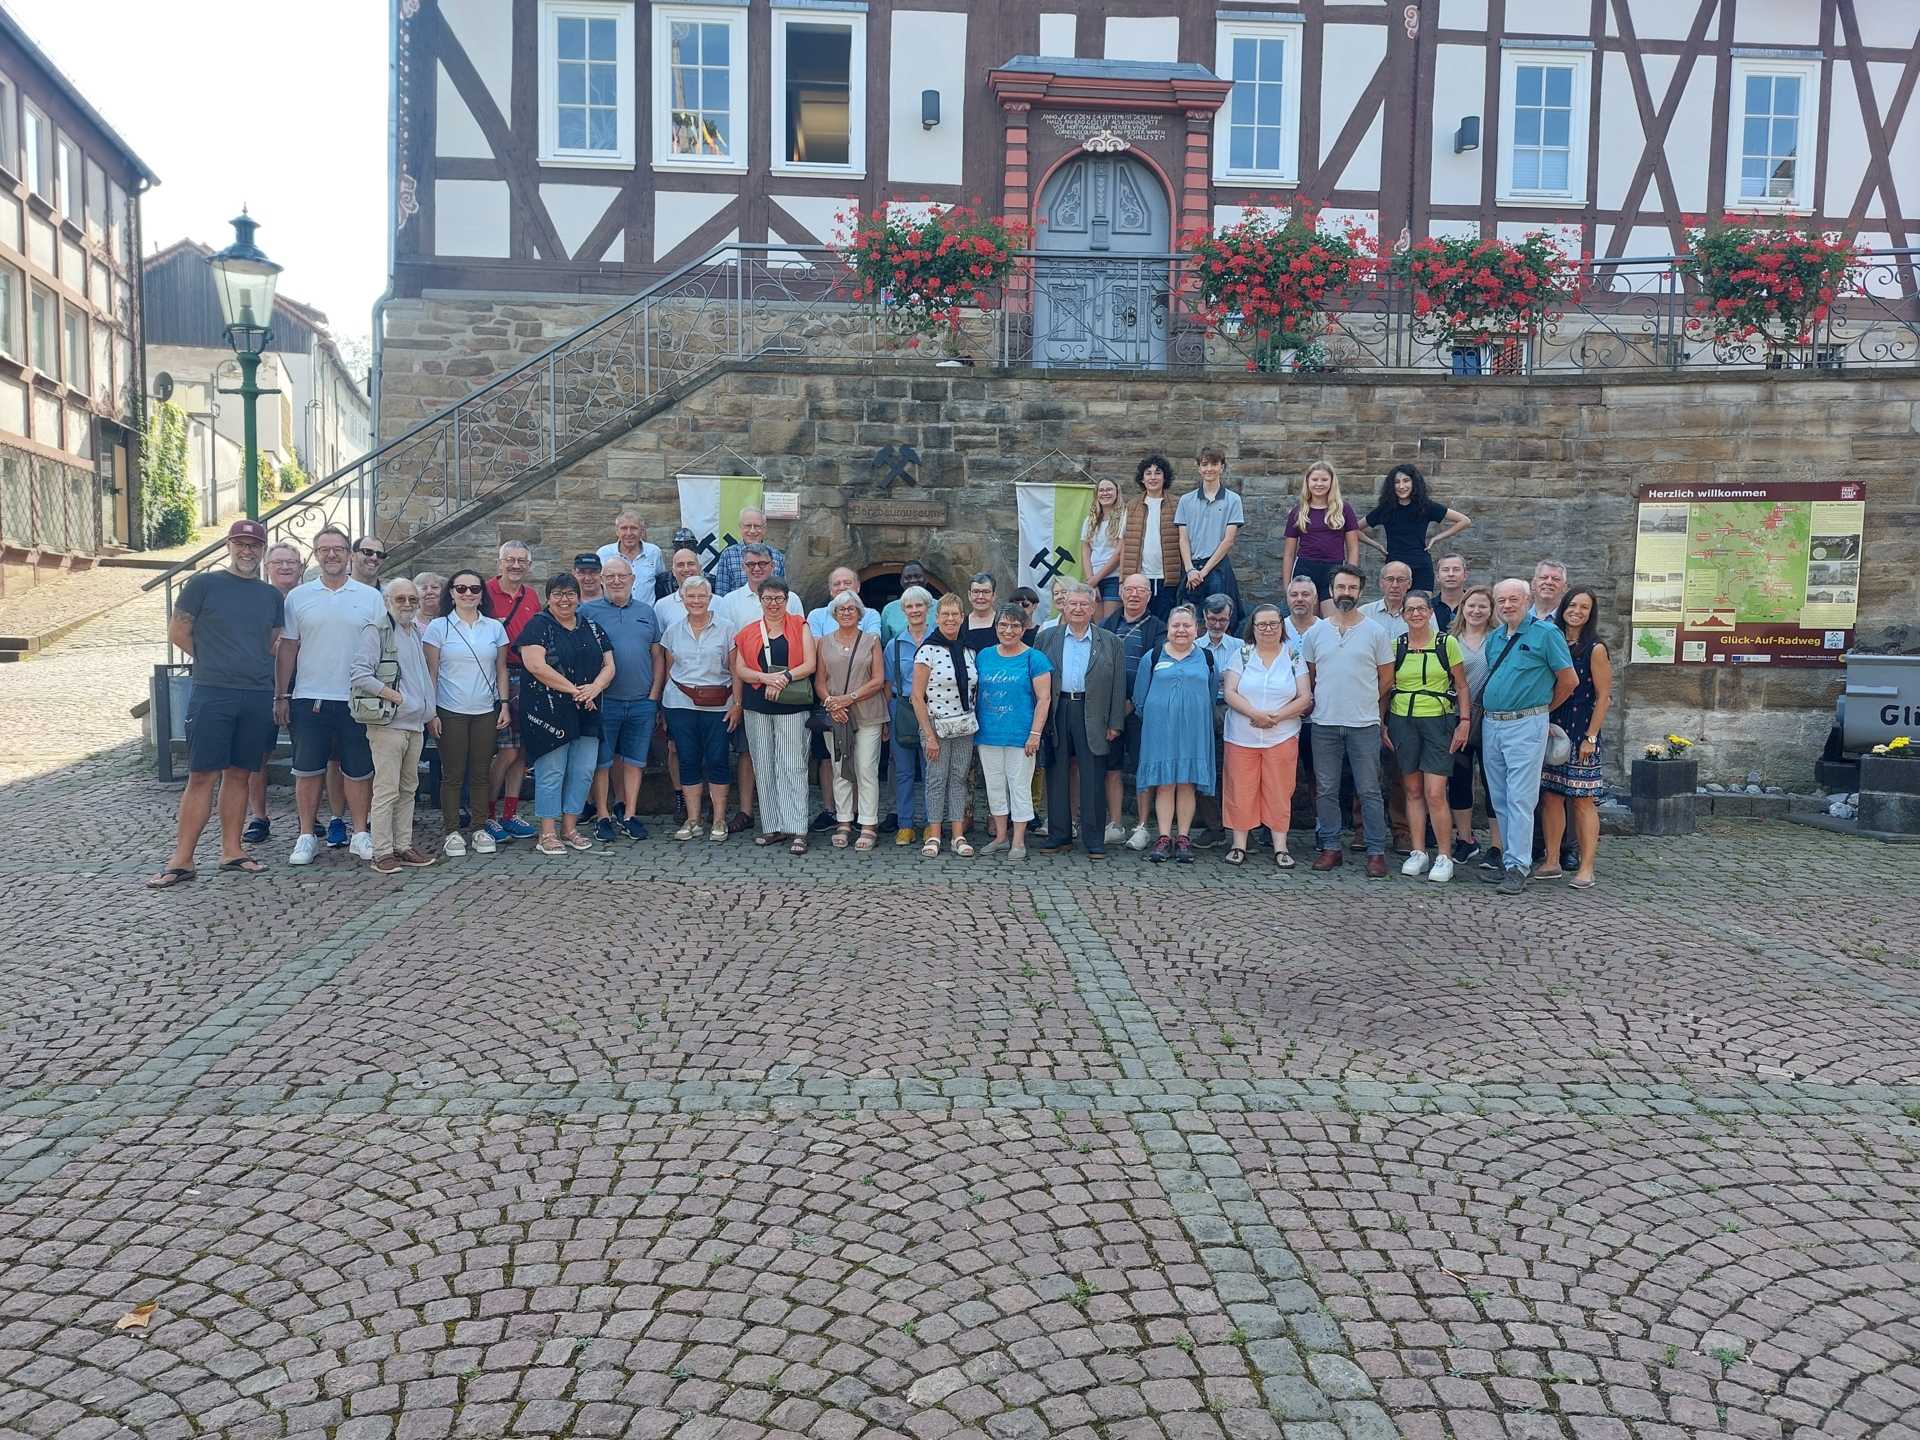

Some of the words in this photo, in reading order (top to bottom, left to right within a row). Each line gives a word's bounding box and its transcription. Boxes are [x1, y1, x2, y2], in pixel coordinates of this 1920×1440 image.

[1648, 489, 1694, 498] Herzlich
[1697, 488, 1767, 498] willkommen
[1720, 635, 1821, 647] Glück-Auf-Radweg
[526, 711, 544, 726] WHAT
